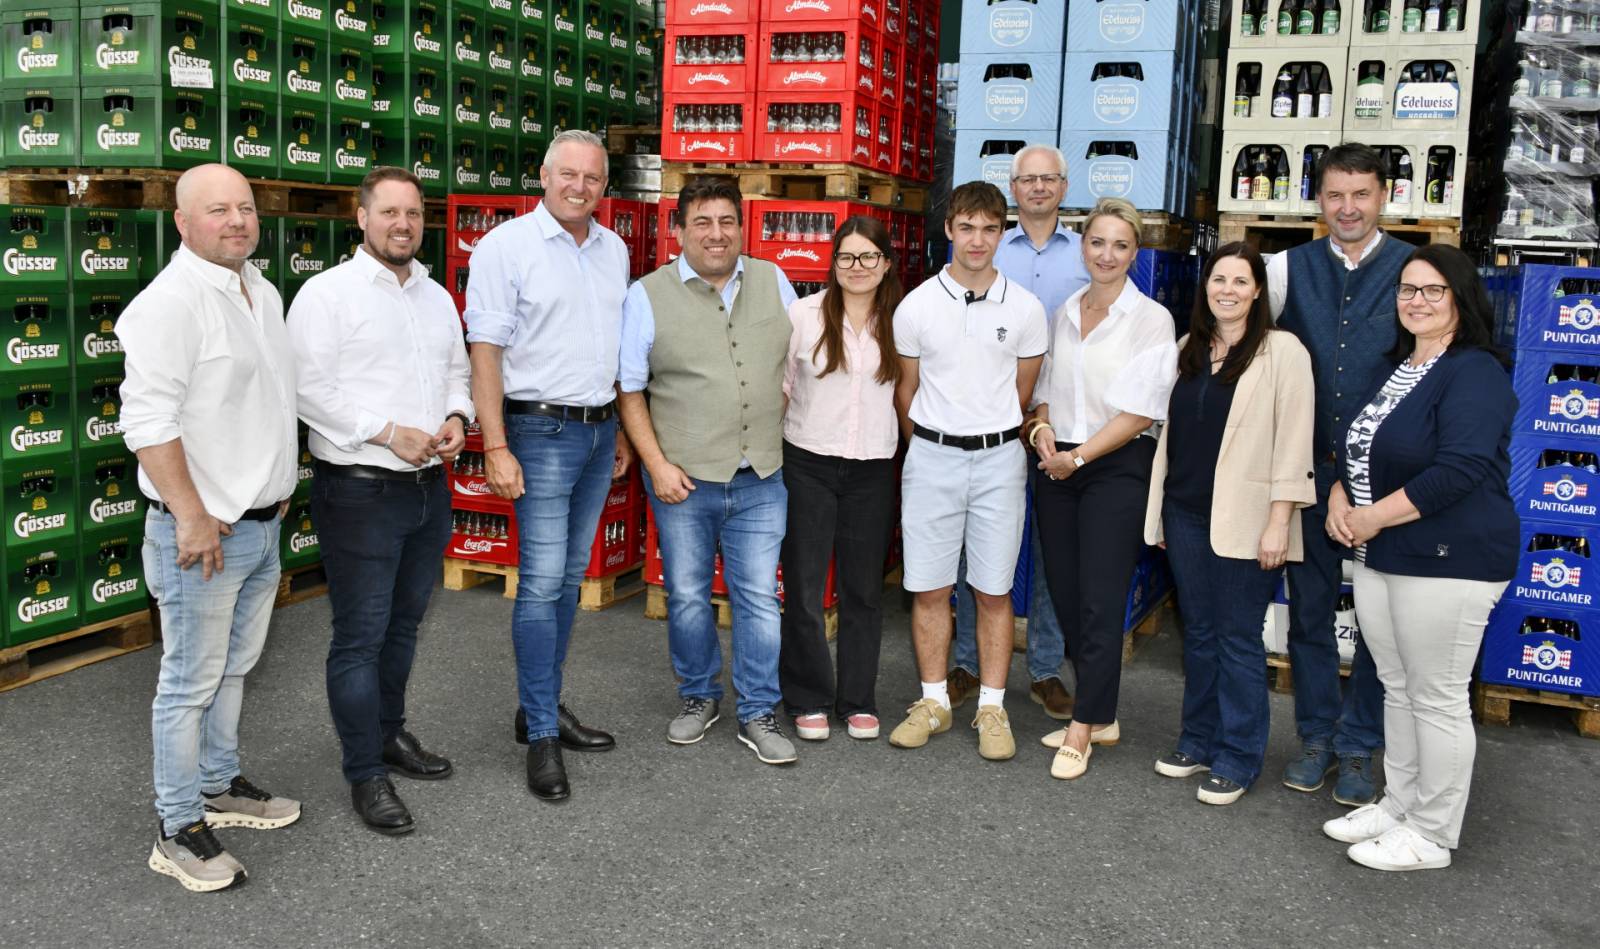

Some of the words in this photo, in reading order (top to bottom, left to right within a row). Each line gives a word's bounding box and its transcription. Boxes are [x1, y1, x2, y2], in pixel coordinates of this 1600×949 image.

[288, 0, 322, 20] Gösser
[691, 3, 732, 15] Almdudler
[786, 0, 831, 12] Almdudler
[335, 9, 367, 30] Gösser
[374, 35, 390, 45] ser
[414, 31, 440, 52] Gösser
[18, 47, 58, 72] Gösser
[96, 43, 139, 69] Gösser
[168, 46, 211, 69] Gösser
[233, 58, 271, 82] Gösser
[688, 72, 730, 85] Almdudler
[784, 71, 827, 84] Almdudler
[287, 70, 321, 93] Gösser
[336, 79, 366, 100] Gösser
[372, 100, 390, 111] ser
[414, 96, 440, 116] Gösser
[1355, 97, 1382, 107] delwei
[1401, 96, 1453, 108] Edelweiss
[18, 124, 59, 151] Gösser
[97, 122, 140, 150] Gösser
[169, 127, 210, 152] Gösser
[234, 135, 271, 158] Gösser
[687, 140, 726, 152] Almdudler
[287, 143, 321, 164] Gösser
[782, 141, 824, 153] Almdudler
[336, 148, 366, 169] Gösser
[414, 161, 440, 180] Gösser
[3, 247, 57, 275] Gösser
[81, 249, 128, 274] Gösser
[291, 253, 323, 274] Gösser
[777, 248, 820, 261] Almdudler
[7, 338, 59, 363] Gösser
[11, 426, 62, 451] Gösser
[86, 416, 120, 441] Göss
[90, 498, 136, 522] Gösser
[1530, 500, 1596, 515] PUNTIGAMER
[14, 512, 65, 537] Gösser
[92, 579, 138, 602] Gösser
[1516, 586, 1591, 604] PUNTIGAMER
[18, 597, 69, 622] Gösser
[1508, 668, 1582, 687] PUNTIGAMER
